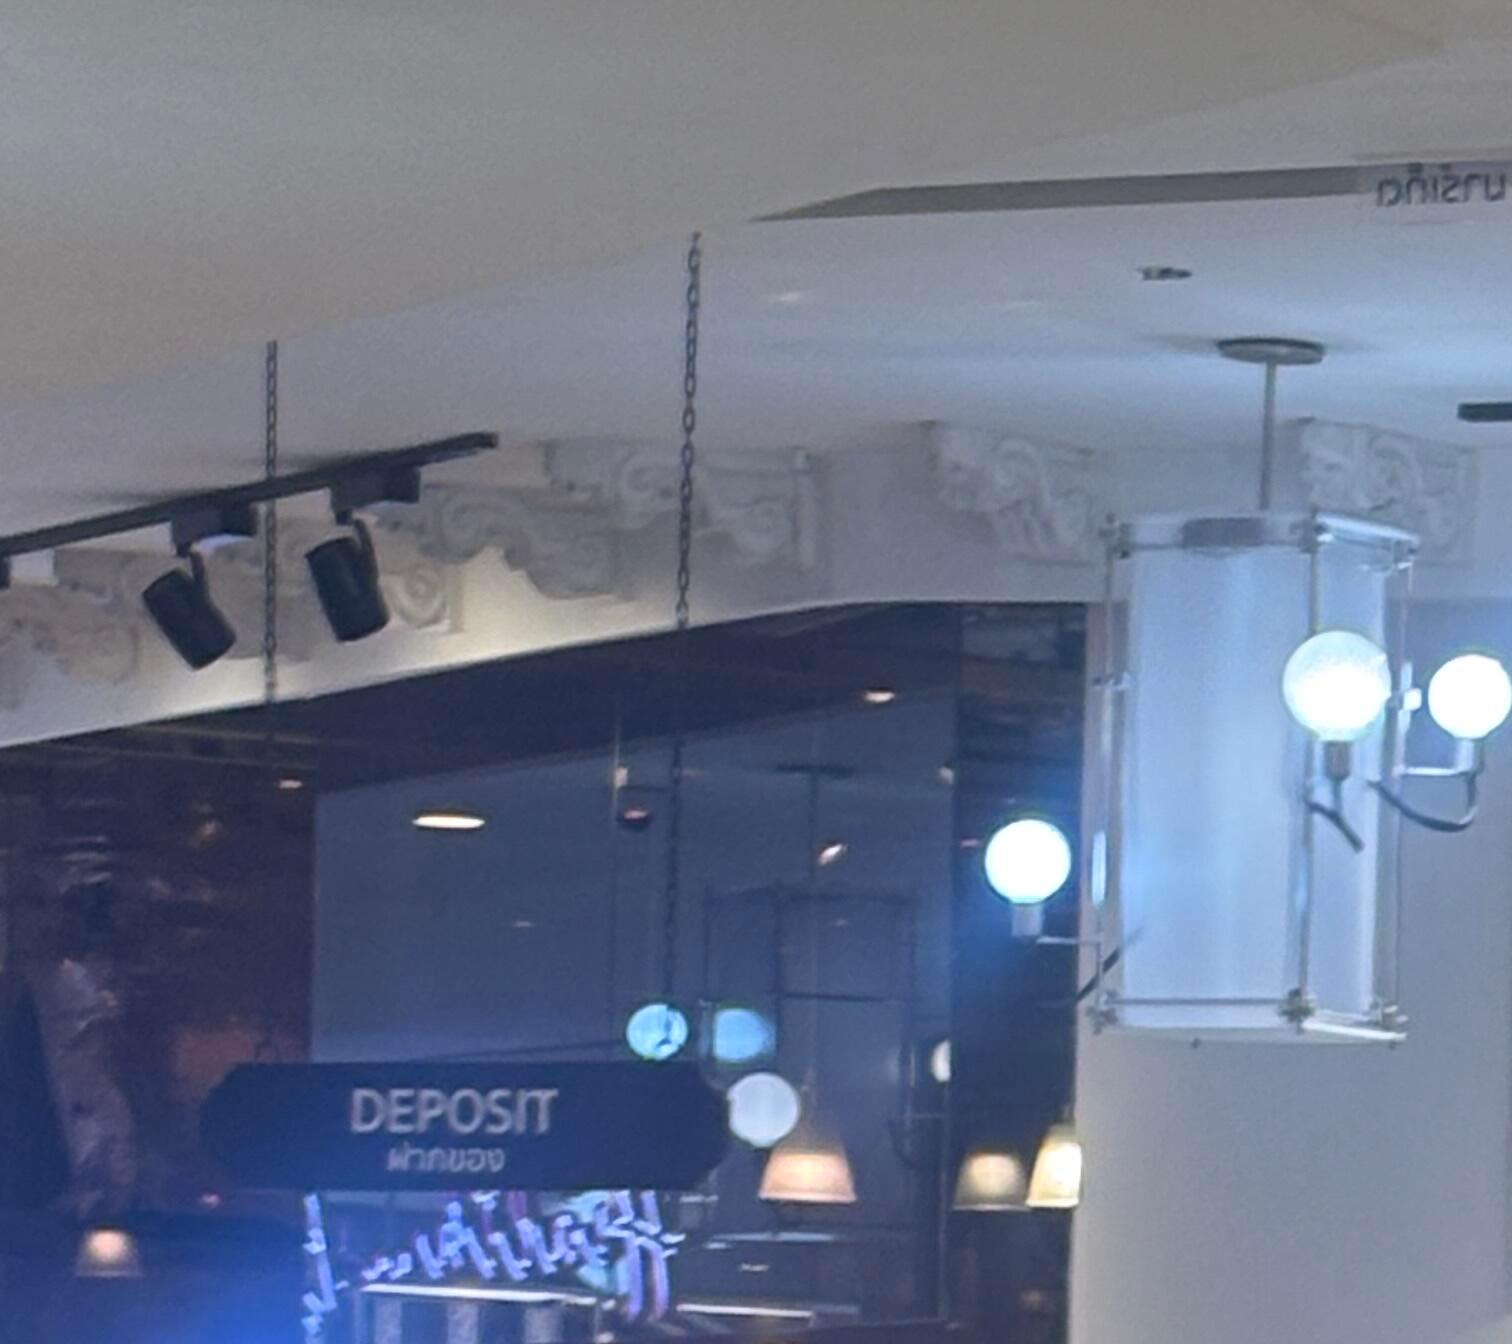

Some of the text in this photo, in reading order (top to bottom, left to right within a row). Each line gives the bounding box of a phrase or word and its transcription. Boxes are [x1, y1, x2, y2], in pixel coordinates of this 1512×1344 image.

[349, 1088, 560, 1136] DEPOSIT
[386, 1146, 505, 1174] ฝากของ
